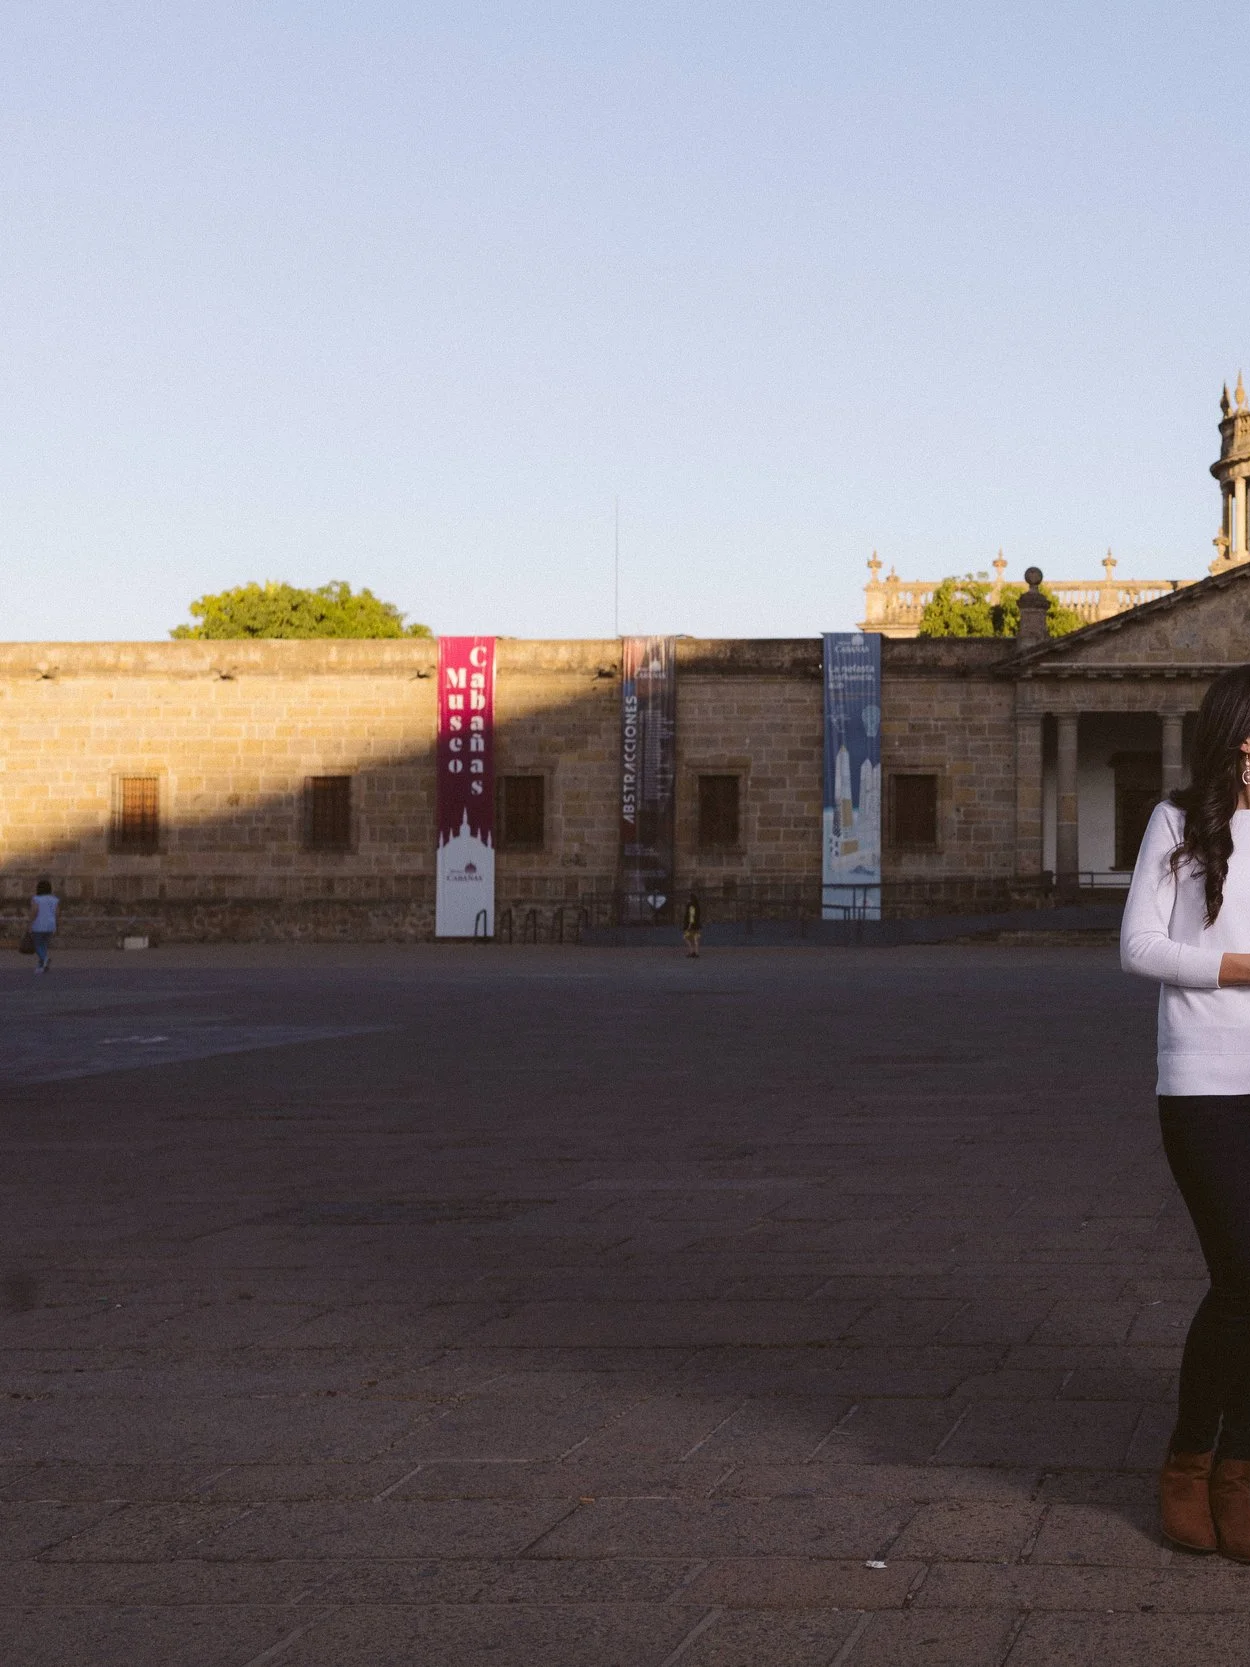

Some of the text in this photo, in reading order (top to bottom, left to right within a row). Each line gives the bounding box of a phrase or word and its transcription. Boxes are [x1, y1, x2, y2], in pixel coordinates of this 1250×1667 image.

[446, 667, 467, 774] Museo
[469, 645, 487, 796] Cabañas
[623, 695, 637, 825] ABSTRACCIONES
